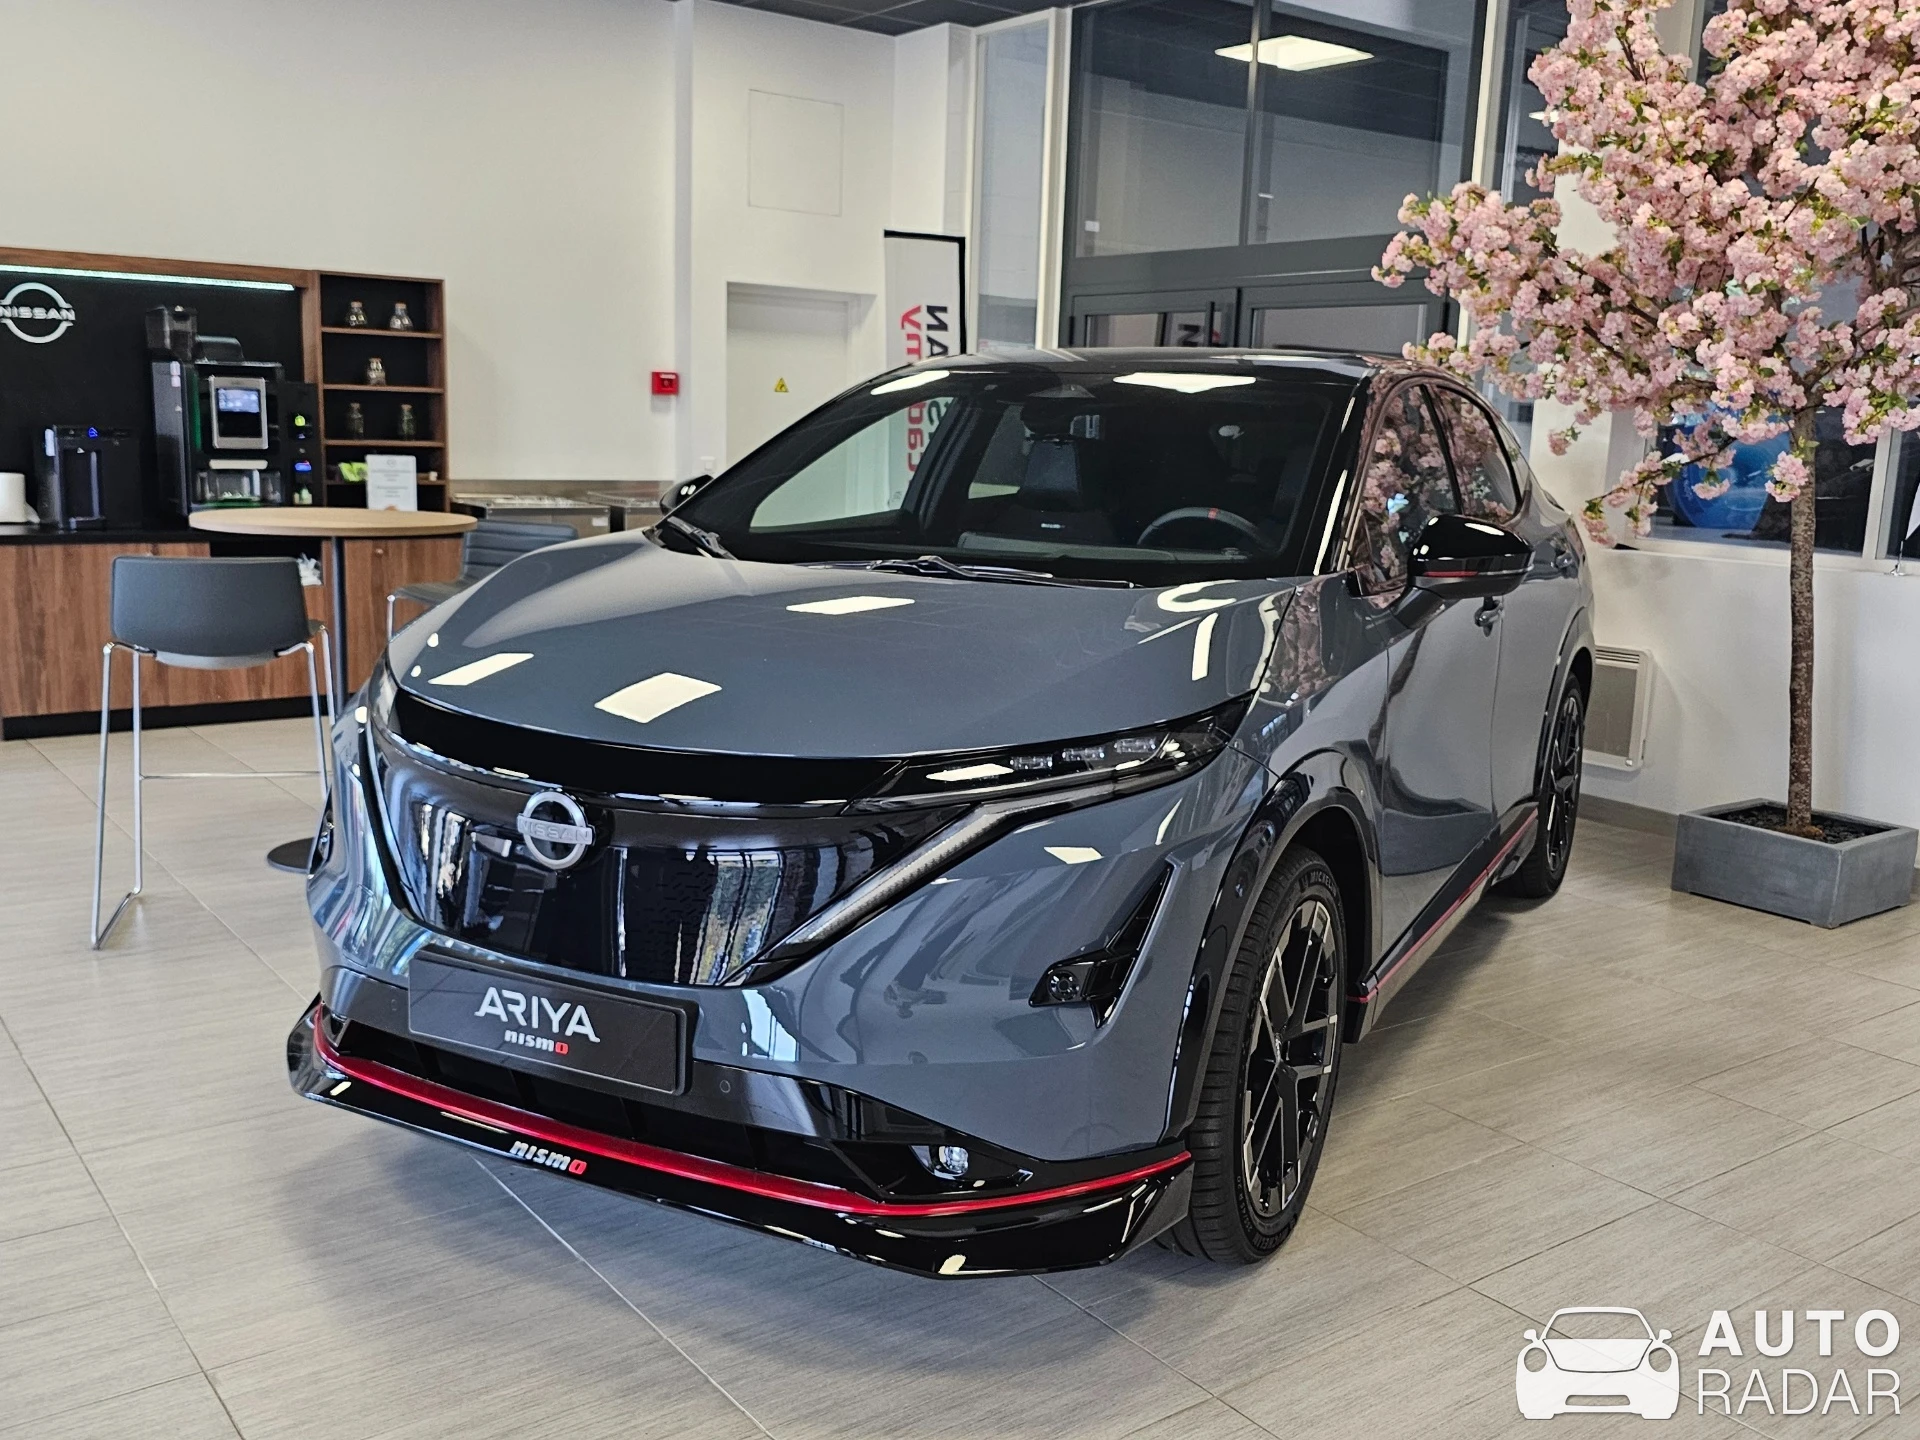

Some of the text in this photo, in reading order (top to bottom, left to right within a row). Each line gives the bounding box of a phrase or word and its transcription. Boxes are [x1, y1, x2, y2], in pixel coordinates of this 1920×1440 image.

[0, 305, 76, 321] NISSAN
[518, 818, 589, 842] NISSAN
[474, 986, 601, 1043] ARIYA
[504, 1029, 569, 1055] nismo
[509, 1140, 588, 1175] nismo
